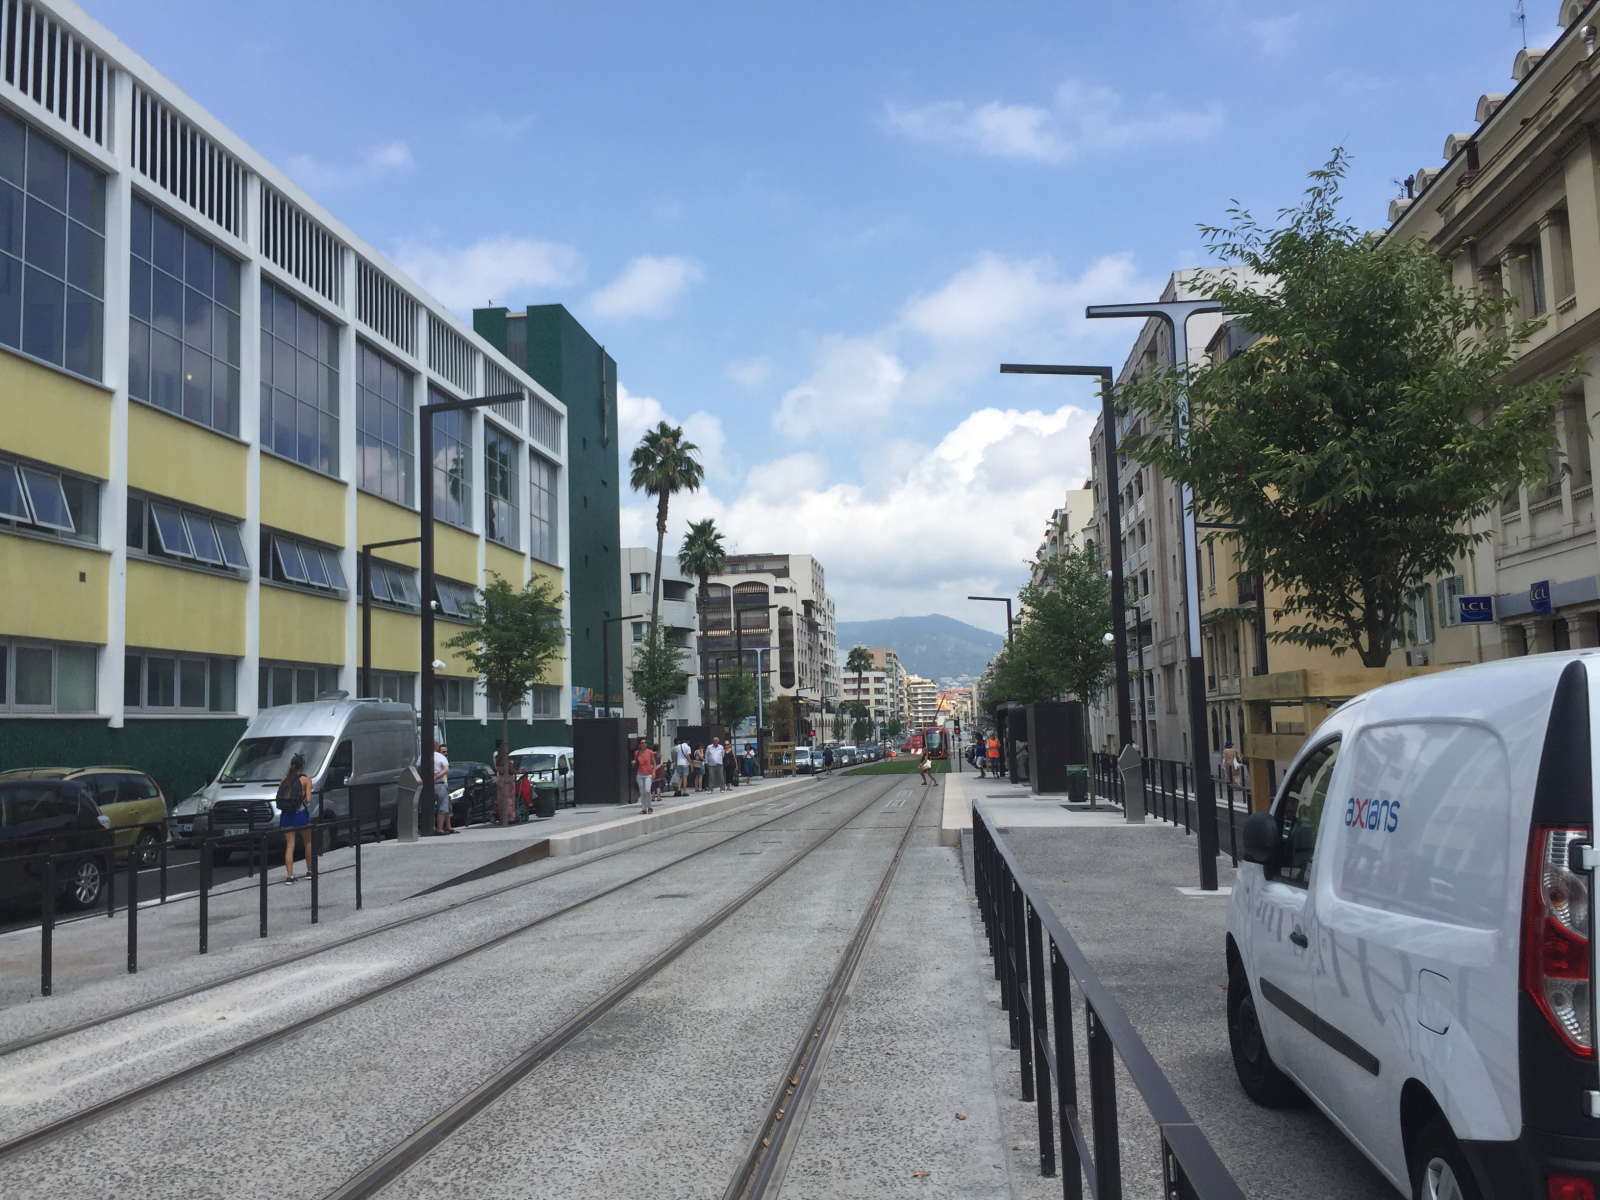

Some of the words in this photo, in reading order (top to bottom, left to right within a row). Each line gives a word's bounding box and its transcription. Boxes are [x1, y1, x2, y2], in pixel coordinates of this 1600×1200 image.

[1530, 588, 1548, 600] LCL
[1461, 602, 1489, 611] LCL
[1344, 797, 1401, 833] axians
